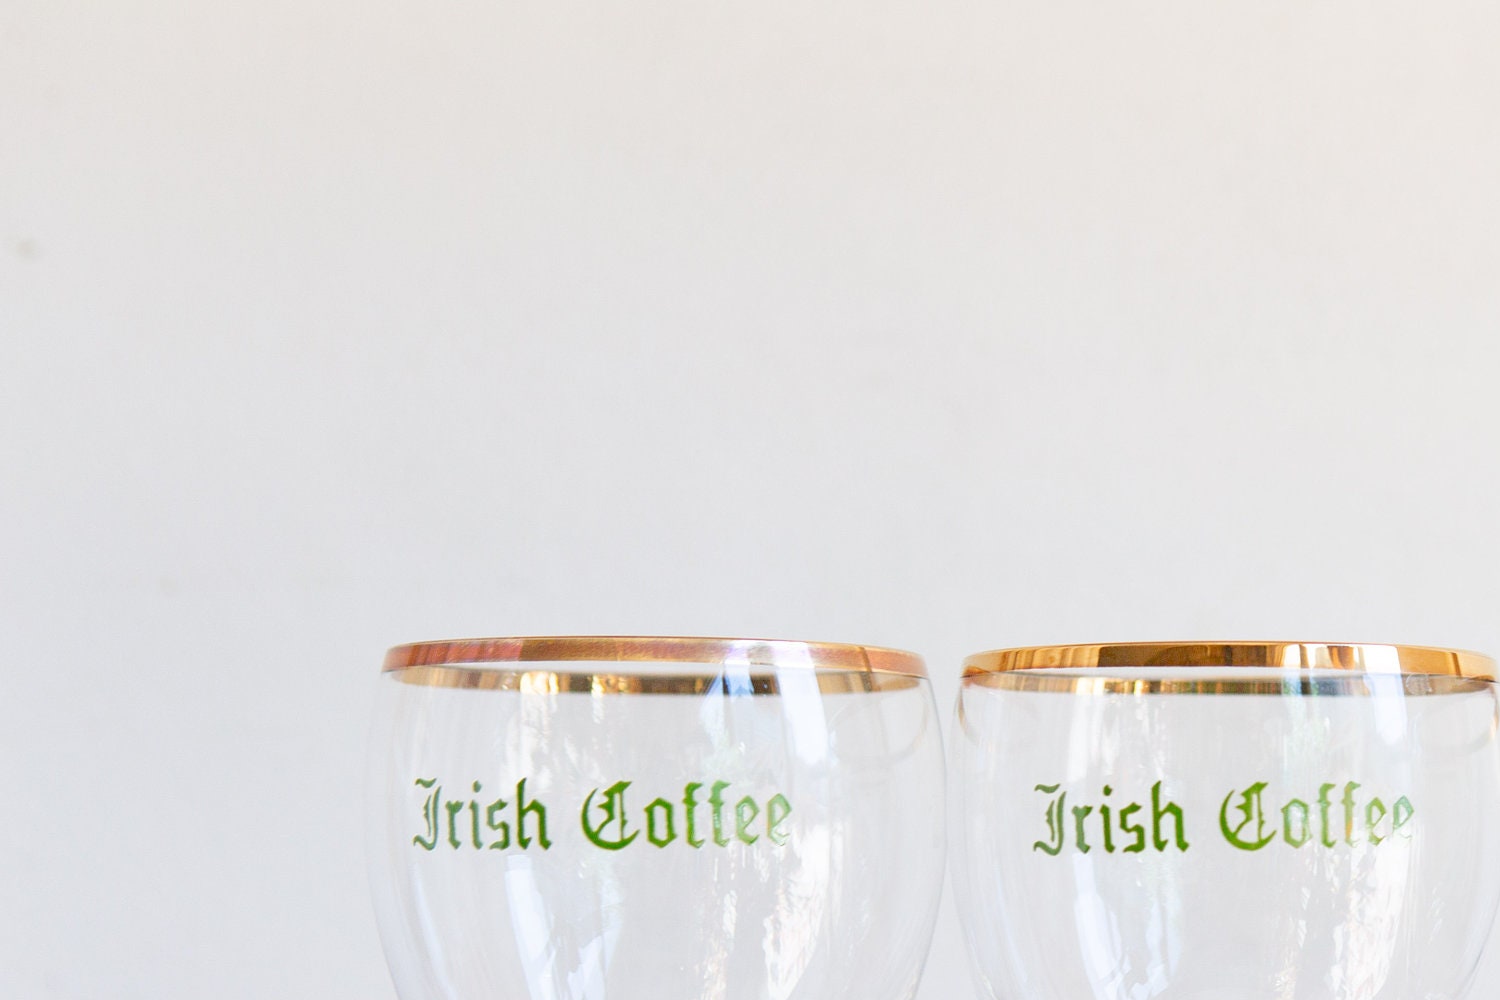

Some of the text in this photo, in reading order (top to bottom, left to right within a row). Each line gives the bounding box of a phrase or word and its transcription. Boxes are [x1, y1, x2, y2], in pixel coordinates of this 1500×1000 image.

[413, 777, 793, 851] Irish Coffee
[1033, 780, 1415, 856] Irish Coffee
